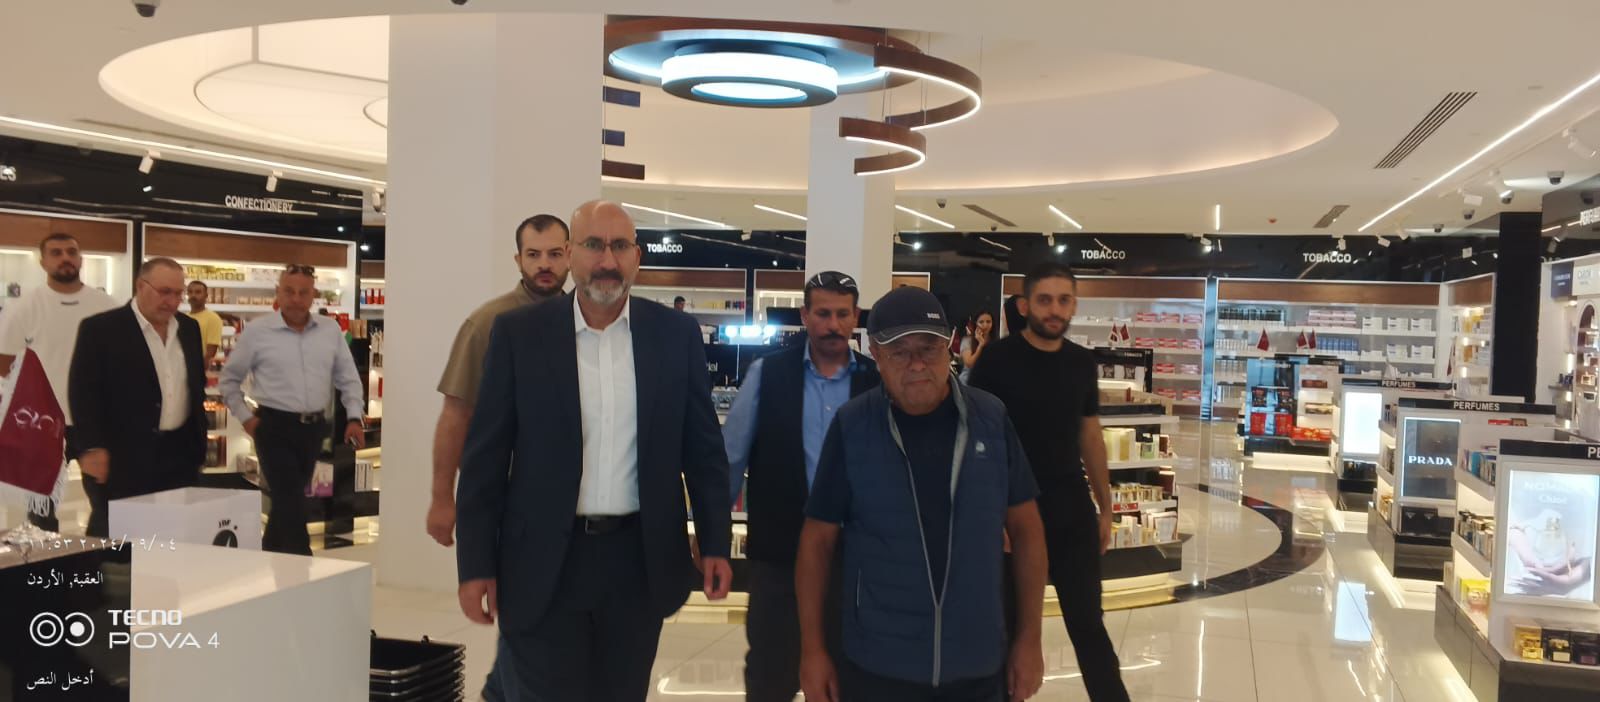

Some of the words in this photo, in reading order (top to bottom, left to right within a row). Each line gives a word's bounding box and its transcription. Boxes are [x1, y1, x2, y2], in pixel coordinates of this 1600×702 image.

[225, 195, 293, 213] CONFECTIONERY
[647, 243, 683, 253] TOBACCO
[1081, 249, 1126, 260] TOBACCO
[1303, 253, 1351, 263] TOBACCO
[1382, 380, 1416, 388] PERFUMES
[1453, 401, 1500, 411] PERFUMES
[1408, 455, 1453, 466] PRADA
